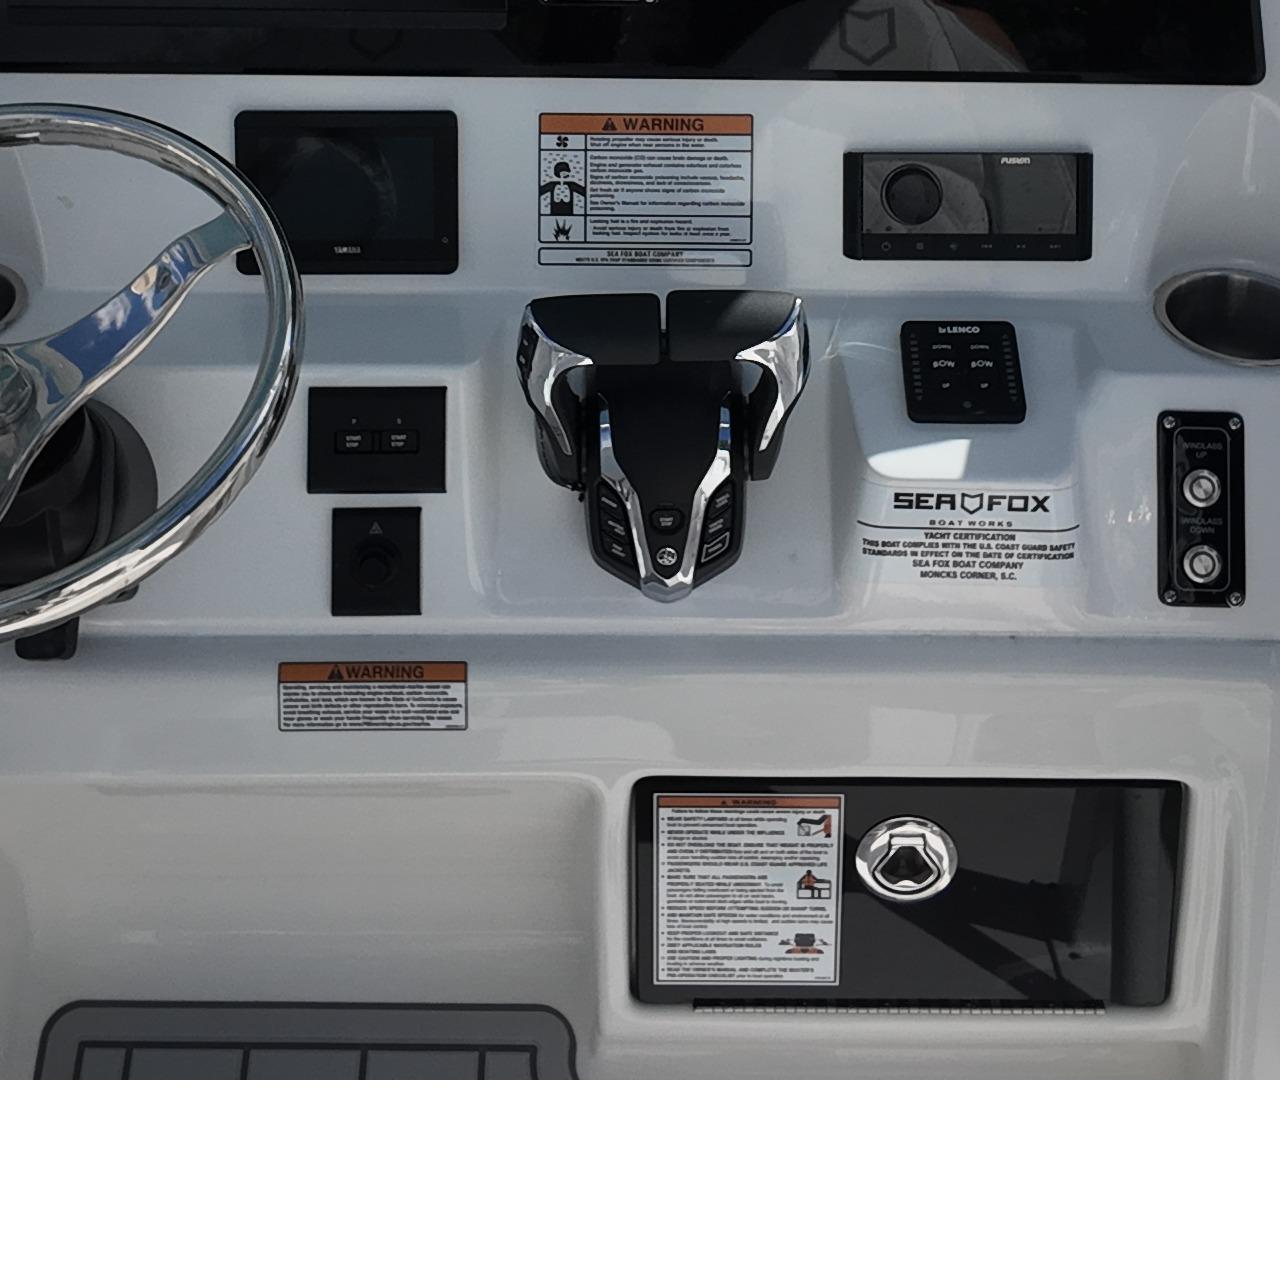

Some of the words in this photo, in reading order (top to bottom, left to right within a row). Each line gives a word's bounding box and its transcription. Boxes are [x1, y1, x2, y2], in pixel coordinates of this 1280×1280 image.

[623, 118, 704, 131] WARNING
[947, 326, 980, 334] LENCO
[932, 359, 956, 368] BOW
[970, 359, 994, 368] BOW
[894, 492, 956, 510] SEA
[987, 495, 1050, 512] FOX
[953, 532, 1016, 541] CERTIFICATION
[862, 537, 879, 547] THIS
[881, 540, 900, 548] BOAT
[1049, 542, 1075, 551] SAFETY
[862, 547, 907, 557] STANDARDS
[1016, 552, 1074, 560] CERTIFICATION
[912, 559, 930, 567] SEA
[952, 560, 976, 568] BOAT
[979, 561, 1024, 569] COMPANY
[920, 570, 957, 578] MONCKS
[959, 571, 998, 580] CORNER,
[1000, 572, 1017, 580] S.C.
[345, 665, 425, 678] WARNING
